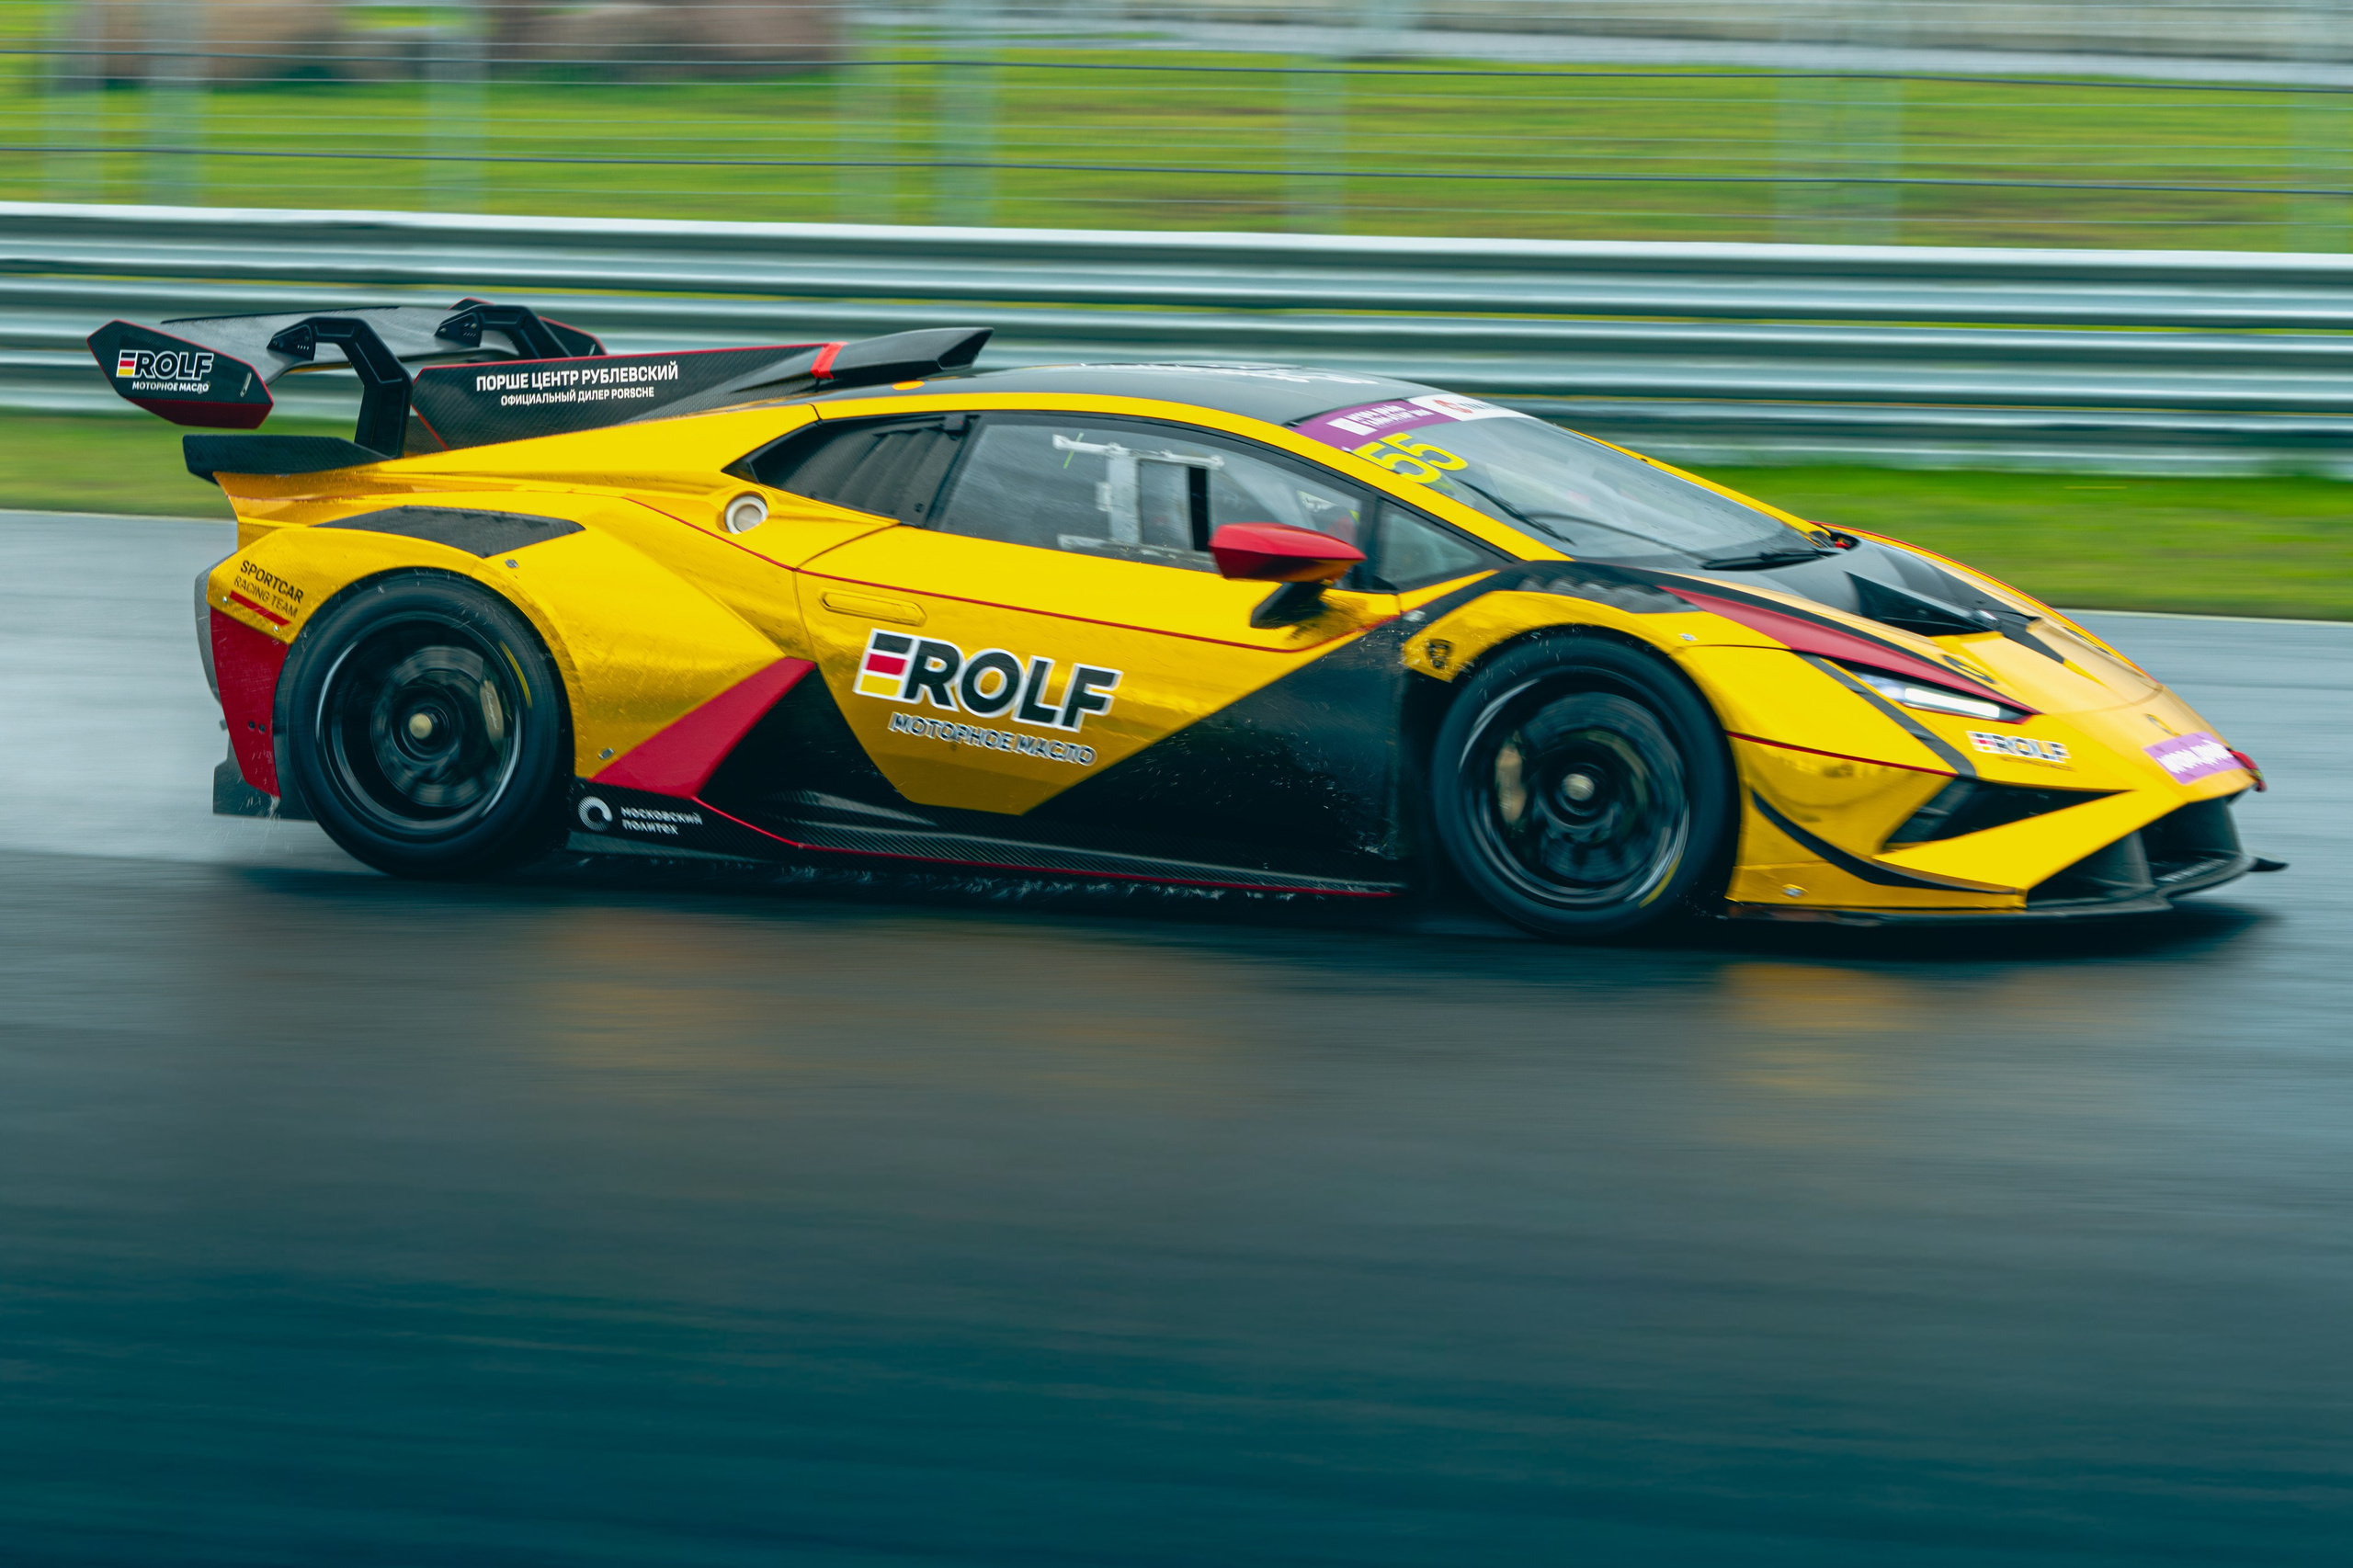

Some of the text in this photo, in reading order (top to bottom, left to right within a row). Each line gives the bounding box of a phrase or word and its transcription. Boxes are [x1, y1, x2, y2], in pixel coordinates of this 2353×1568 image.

[133, 349, 213, 381] ROLF
[476, 360, 678, 392] ПОРШЕ ЦЕНТР РУБЛЕВСКИЙ
[131, 381, 210, 393] МОТОРНОЕ МАСЛО
[501, 386, 654, 406] ОФИЦИАЛЬНЫЙ ДИЛЕР PORSCHE
[1350, 432, 1469, 483] 55
[233, 575, 299, 619] RACING TEAM
[240, 560, 304, 604] SPORTCAR
[903, 636, 1123, 733] ROLF
[888, 711, 1015, 754] МОТОРНОЕ
